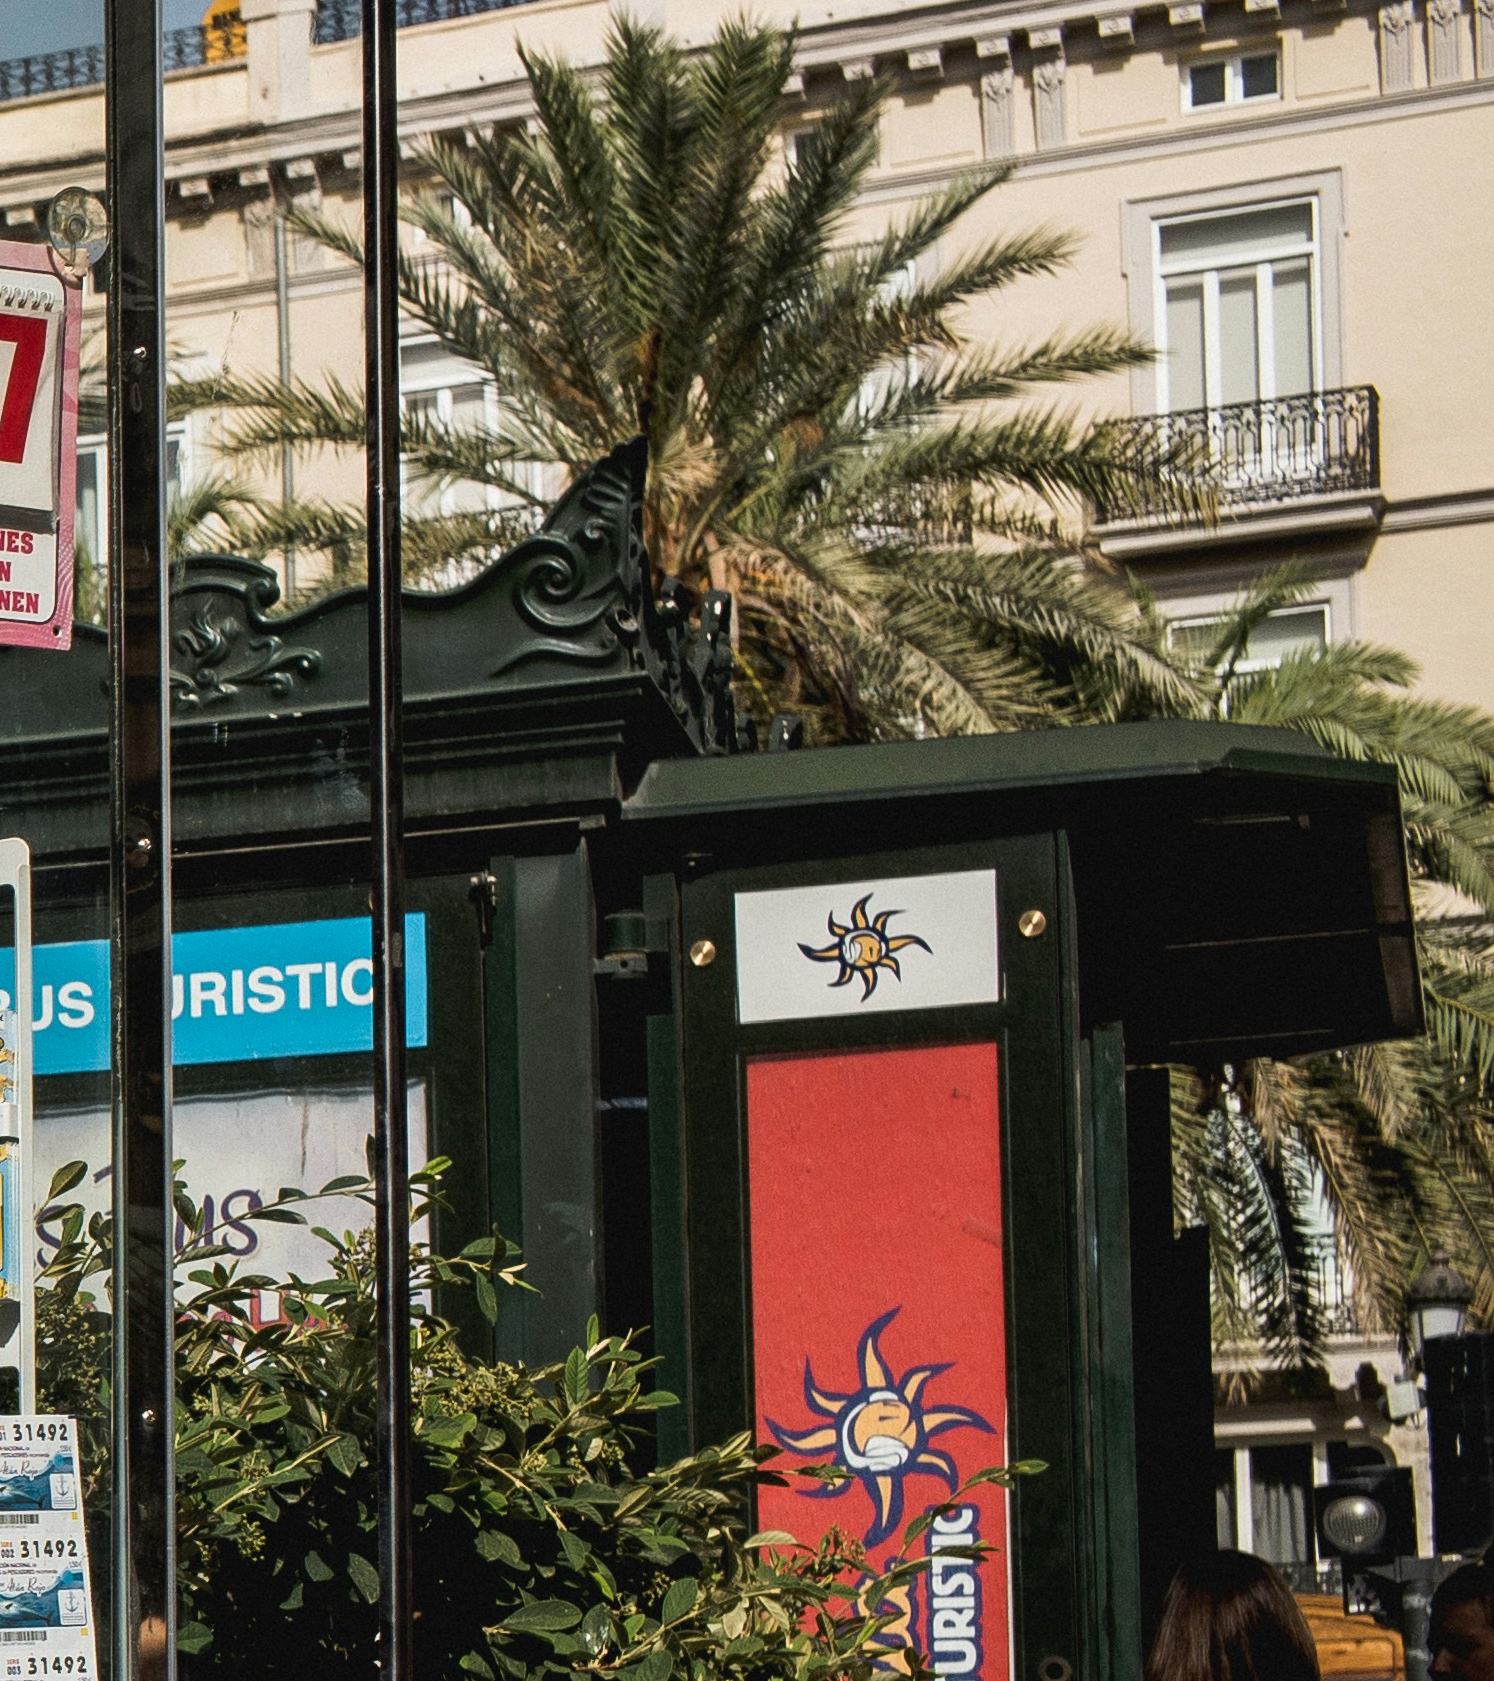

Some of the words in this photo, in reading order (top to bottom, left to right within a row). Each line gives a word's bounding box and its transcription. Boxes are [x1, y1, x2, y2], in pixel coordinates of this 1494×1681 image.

[13, 1424, 68, 1441] 31492
[21, 1540, 77, 1558] 31492
[27, 1657, 87, 1675] 31492
